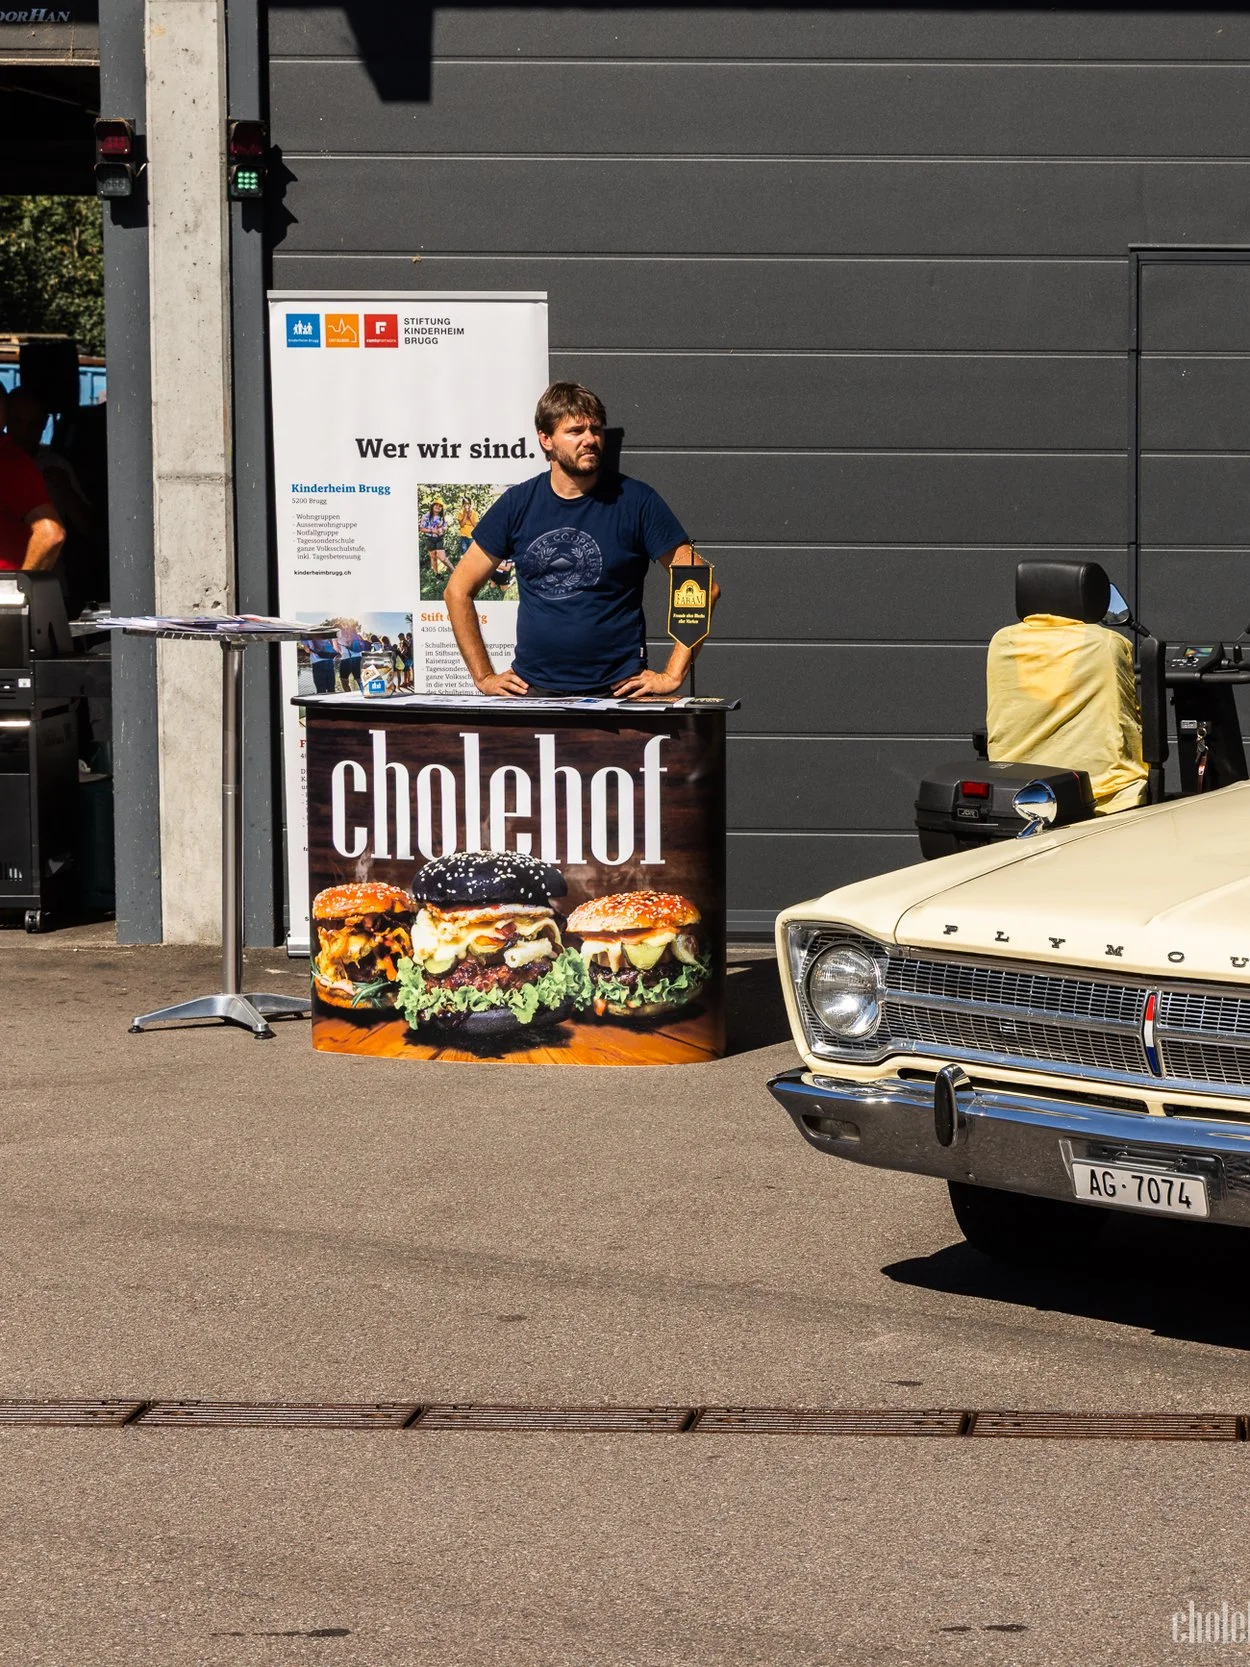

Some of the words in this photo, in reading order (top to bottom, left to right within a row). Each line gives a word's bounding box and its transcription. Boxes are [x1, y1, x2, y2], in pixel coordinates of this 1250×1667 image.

[403, 317, 451, 326] STIFTUNG
[403, 327, 465, 336] KINDERHEIM
[404, 337, 439, 345] BRUGG
[355, 438, 410, 459] Wer
[417, 437, 462, 459] wir
[469, 436, 536, 460] sind.
[291, 483, 356, 493] Kinderheim
[358, 483, 391, 496] Brugg
[531, 540, 550, 556] LEE
[553, 532, 594, 557] COOPER
[421, 612, 444, 621] Stift
[331, 728, 671, 867] cholehof
